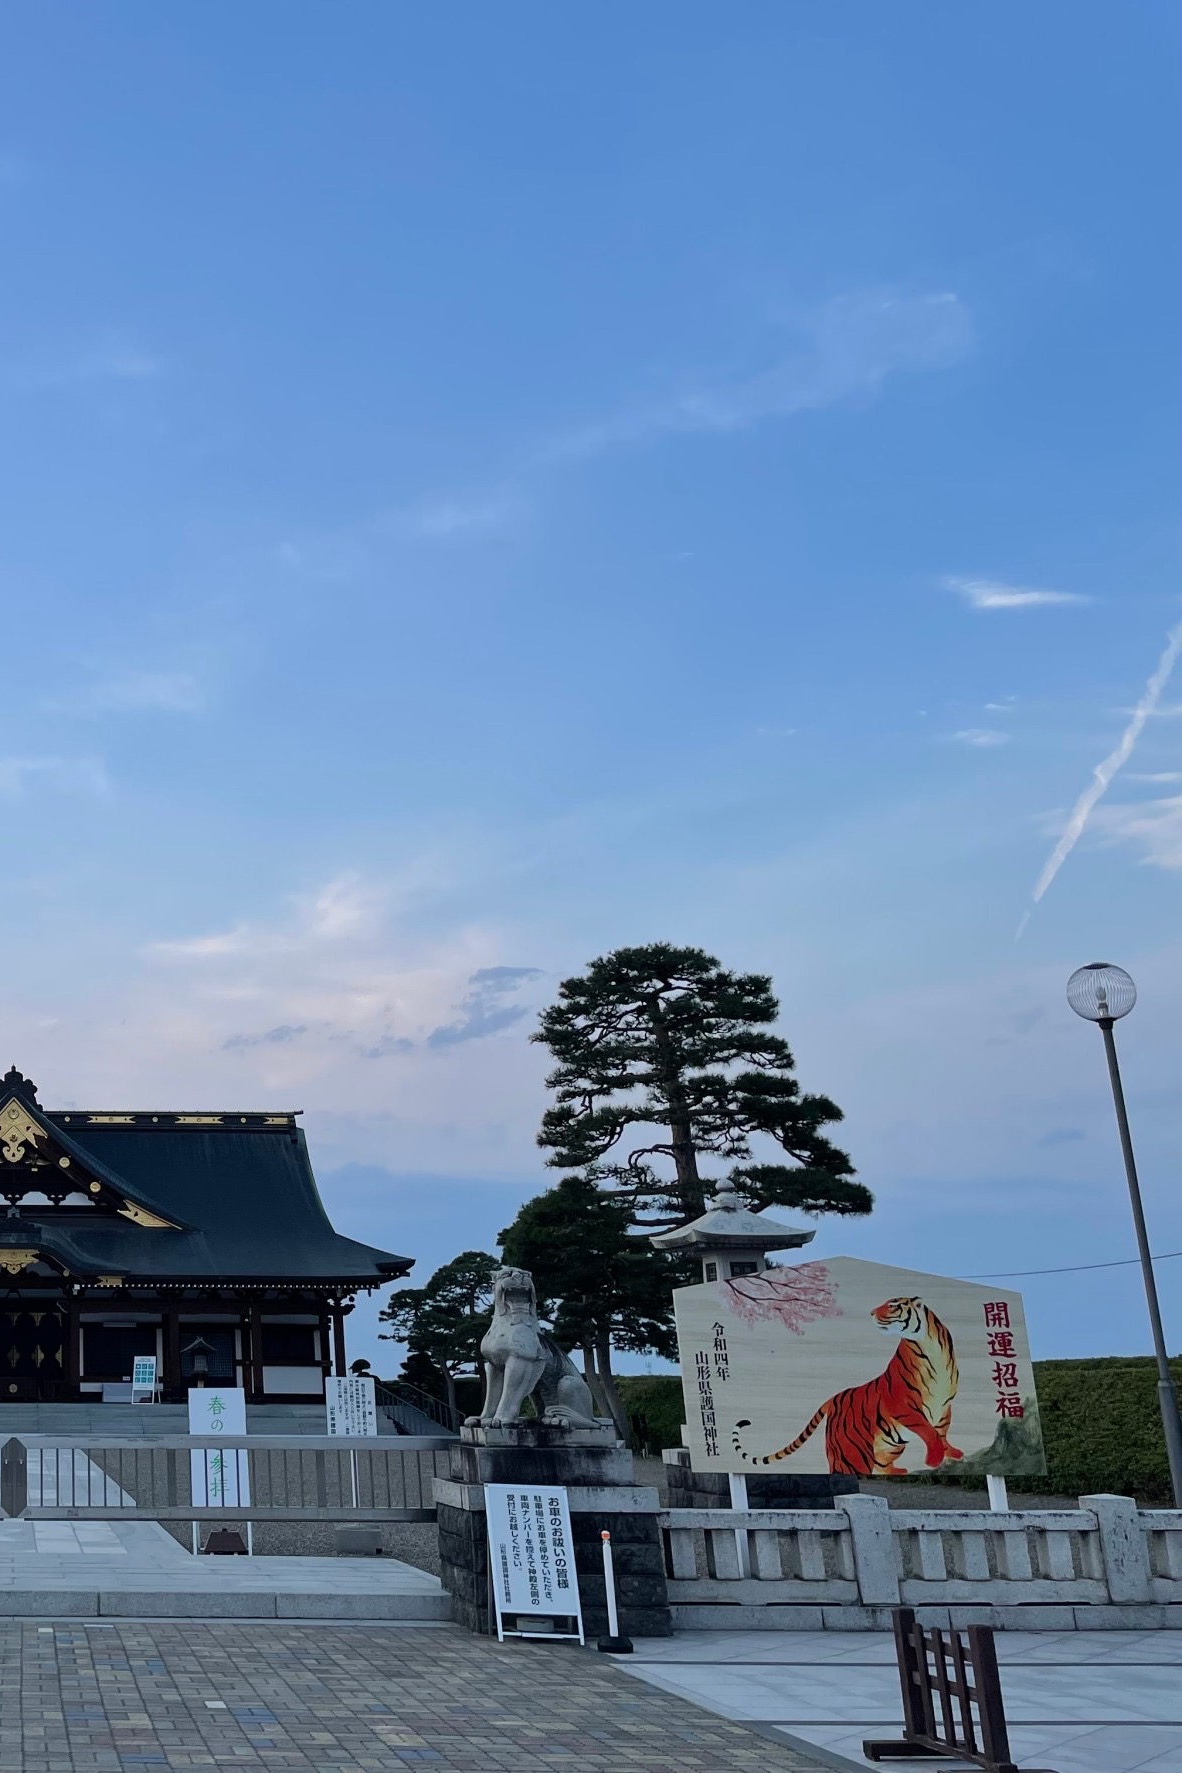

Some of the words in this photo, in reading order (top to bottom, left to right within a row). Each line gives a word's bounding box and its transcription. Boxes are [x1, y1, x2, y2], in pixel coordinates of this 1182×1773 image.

[711, 1321, 730, 1381] 令和四年
[983, 1301, 1024, 1418] 開運招福
[695, 1350, 719, 1457] 山形県護国神社
[506, 1493, 523, 1571] 受付にお越しください。
[520, 1494, 540, 1606] 車両ナンバーを控えて神殿左側の
[548, 1497, 569, 1589] お車のお祓いの皆様
